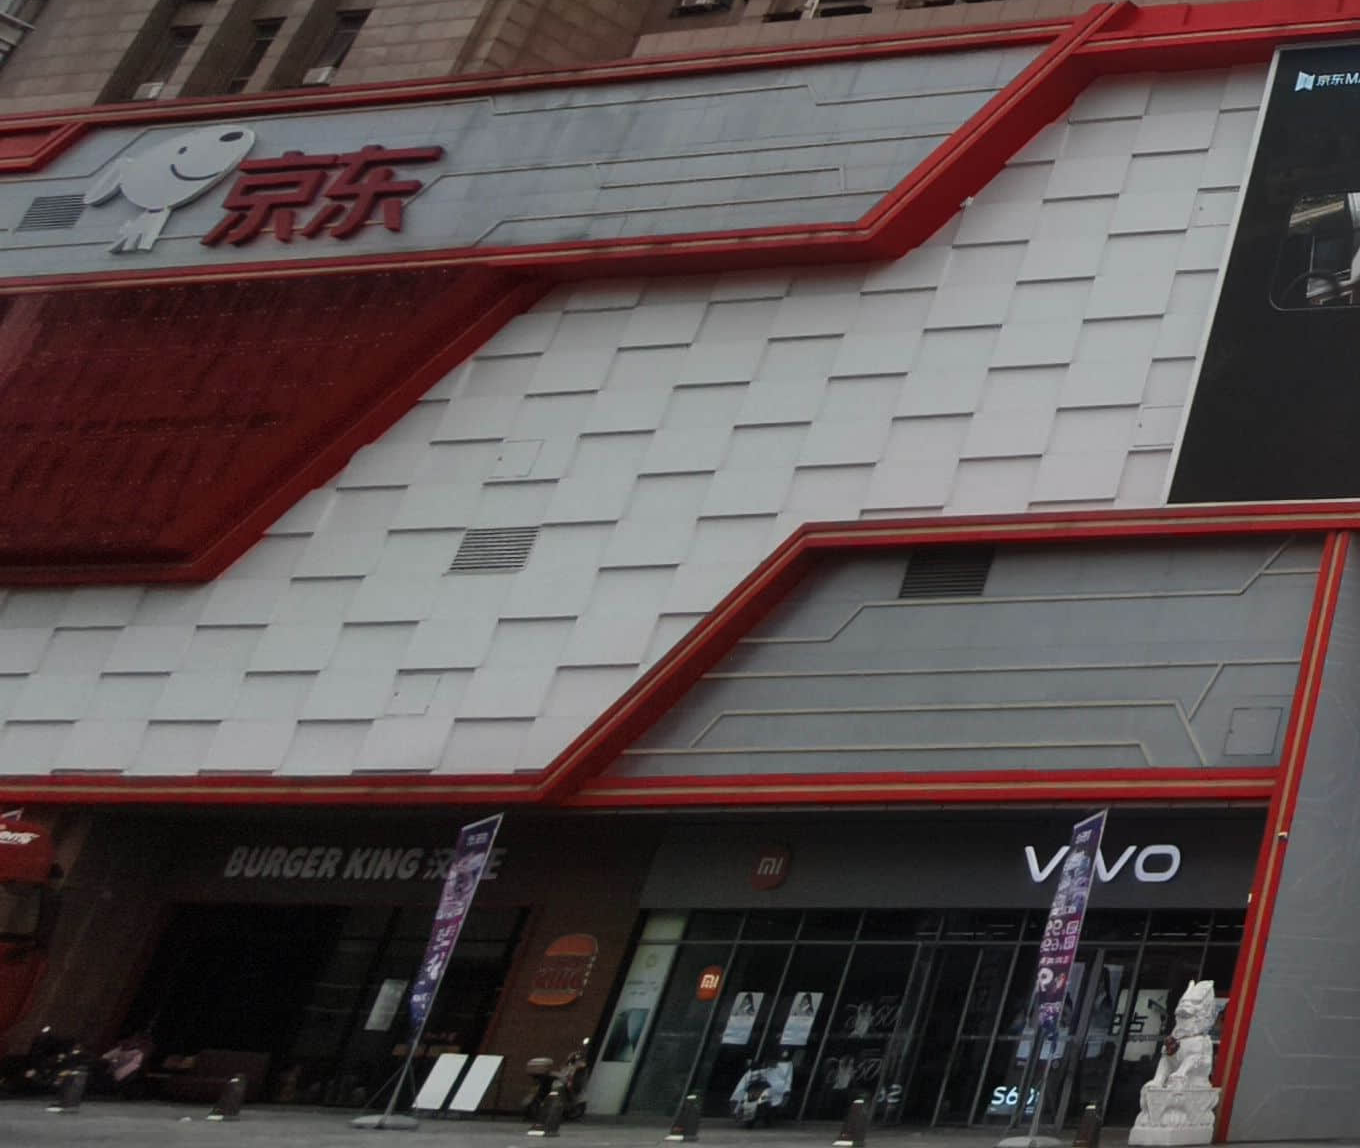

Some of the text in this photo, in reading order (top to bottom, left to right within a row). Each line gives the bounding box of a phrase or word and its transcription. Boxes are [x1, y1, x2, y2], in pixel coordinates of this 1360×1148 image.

[201, 144, 446, 247] 京东
[224, 846, 345, 879] BURGER
[343, 846, 423, 880] KING
[1024, 845, 1181, 883] vvo
